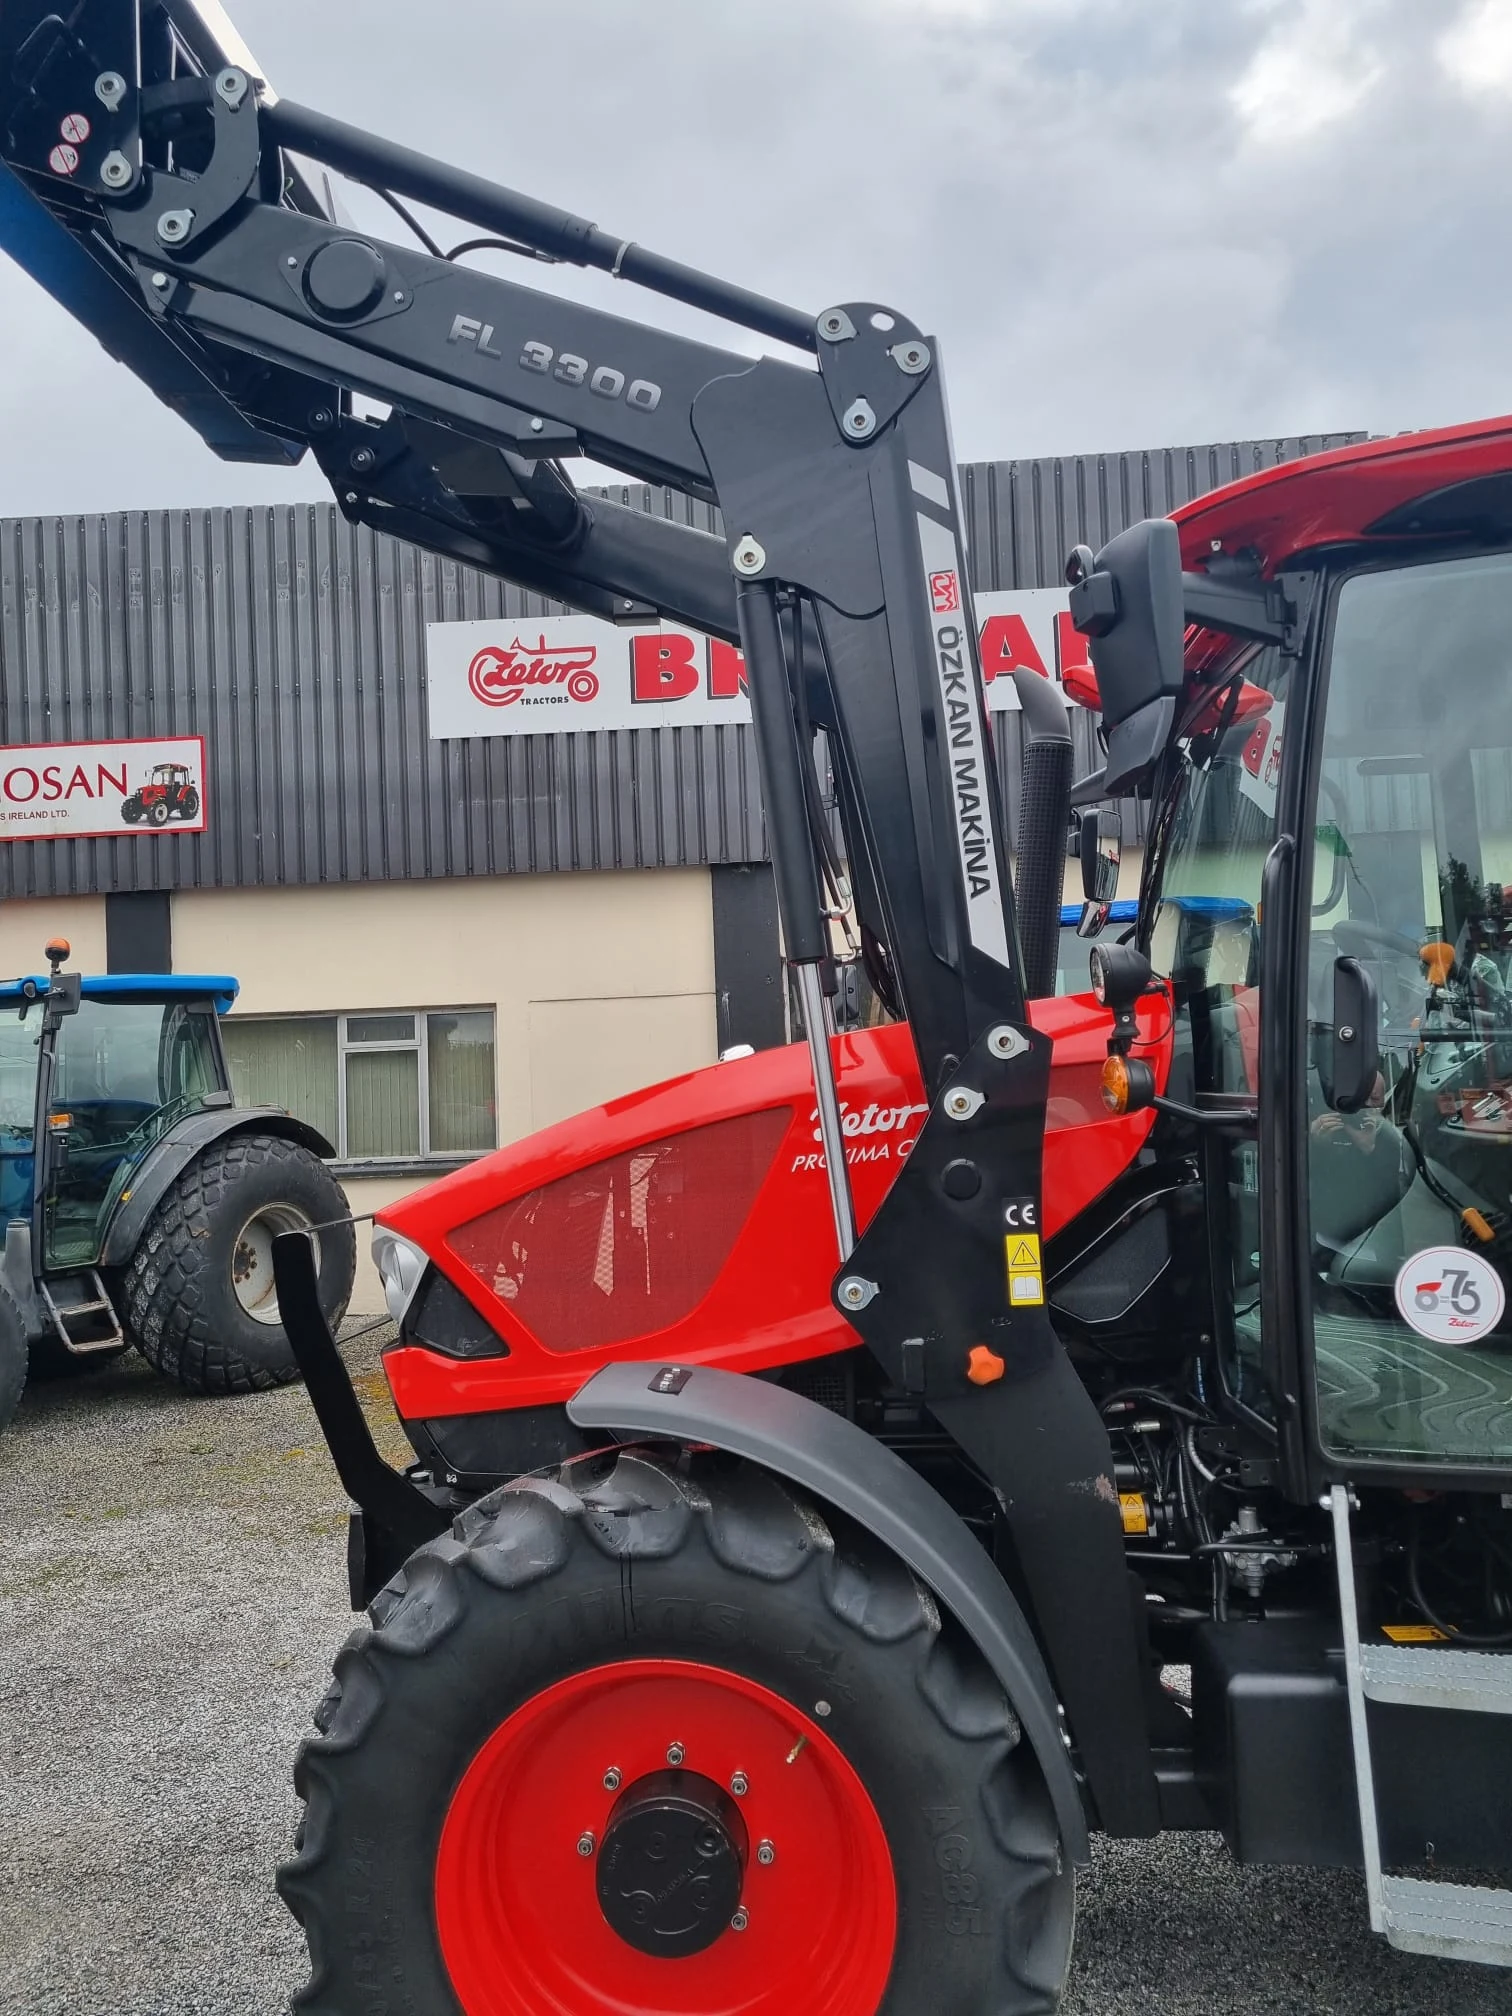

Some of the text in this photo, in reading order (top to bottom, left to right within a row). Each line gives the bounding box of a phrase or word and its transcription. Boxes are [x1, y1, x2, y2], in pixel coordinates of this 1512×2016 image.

[449, 314, 662, 411] FL 3300
[520, 696, 569, 705] TRACTORS
[937, 625, 992, 898] ÖZKAN MAKİNA
[8, 810, 49, 820] IRELAND
[50, 810, 70, 818] LTD.
[1005, 1204, 1036, 1226] CE
[1442, 1269, 1481, 1316] 75
